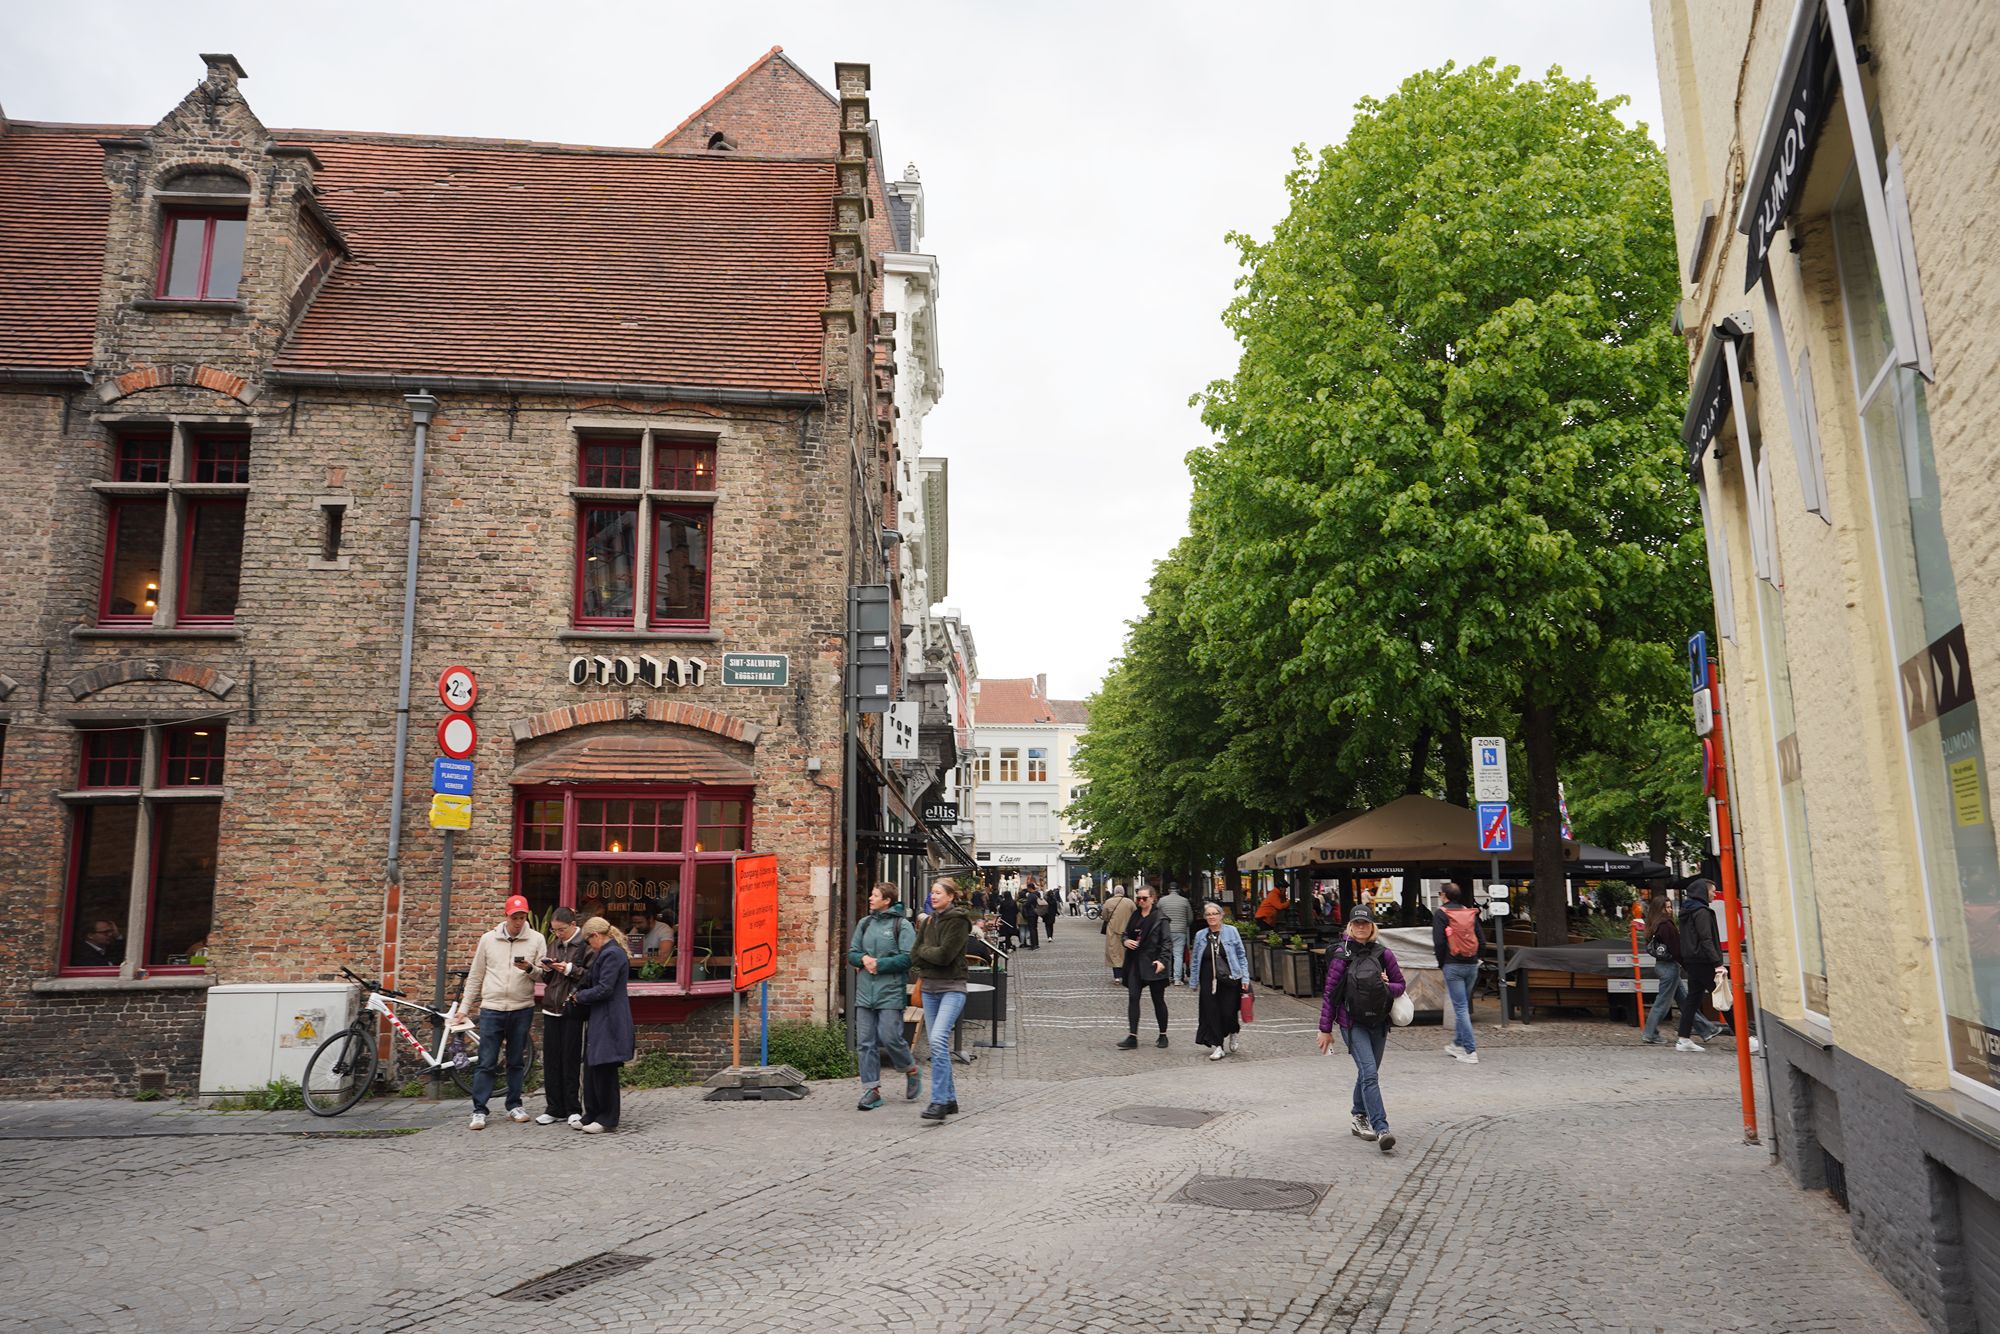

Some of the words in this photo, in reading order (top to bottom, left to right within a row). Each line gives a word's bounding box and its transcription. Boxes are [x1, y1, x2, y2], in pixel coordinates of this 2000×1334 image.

[569, 653, 707, 688] OTOMAT
[1478, 739, 1500, 747] ZONE
[925, 805, 956, 818] ellis
[999, 854, 1022, 862] Etam
[1320, 849, 1374, 861] OTOMAT
[587, 880, 671, 900] OTOMAT
